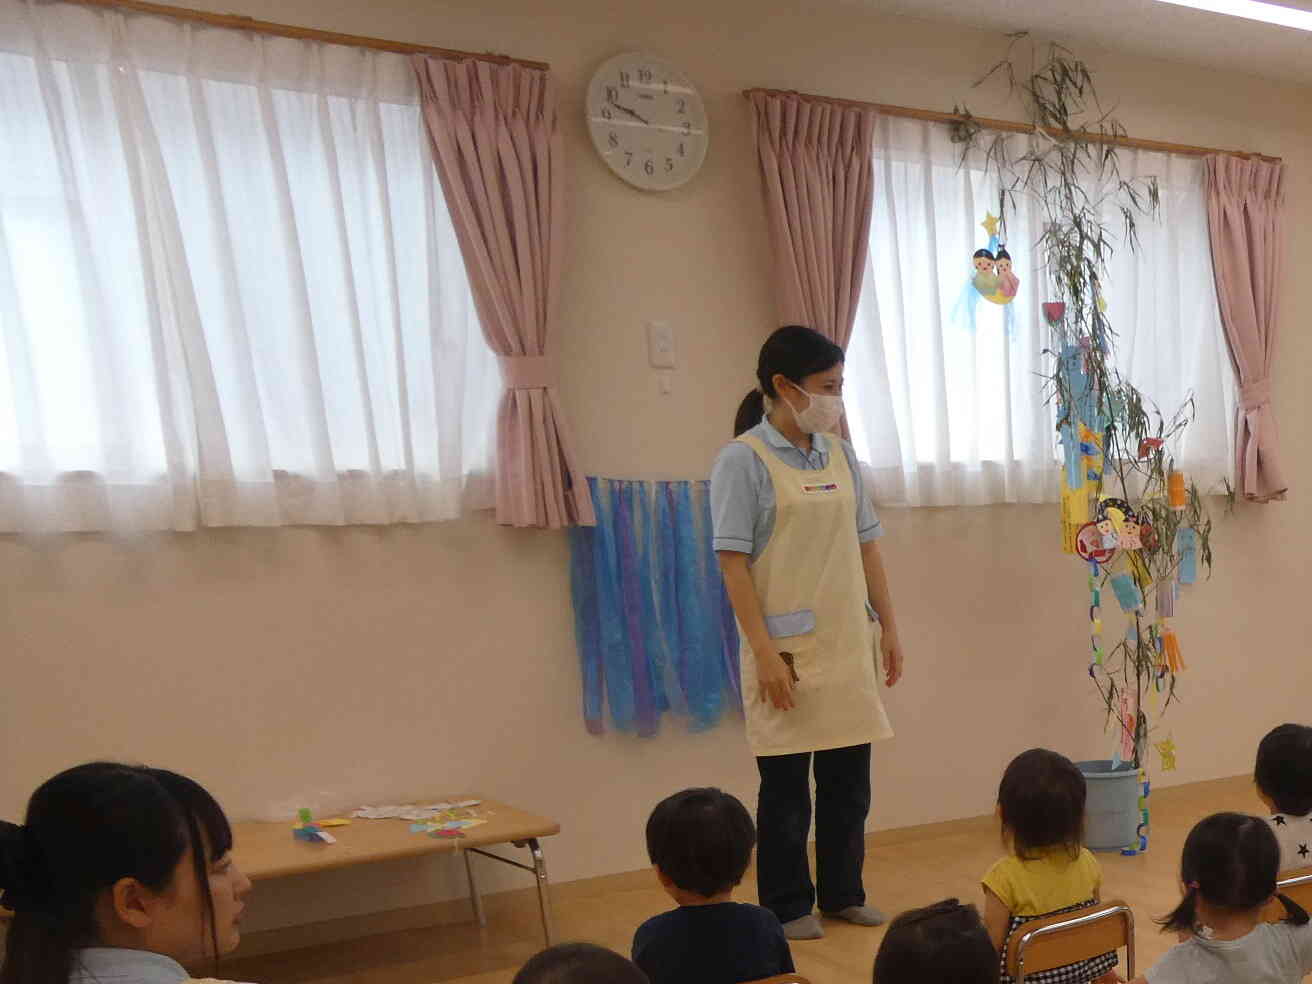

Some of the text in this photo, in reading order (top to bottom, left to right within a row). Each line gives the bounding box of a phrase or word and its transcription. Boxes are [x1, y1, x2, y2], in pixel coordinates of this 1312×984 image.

[676, 99, 686, 115] 2
[680, 121, 691, 137] 3
[608, 131, 619, 148] 8
[623, 151, 633, 169] 7
[644, 159, 655, 176] 6
[663, 156, 674, 173] 5
